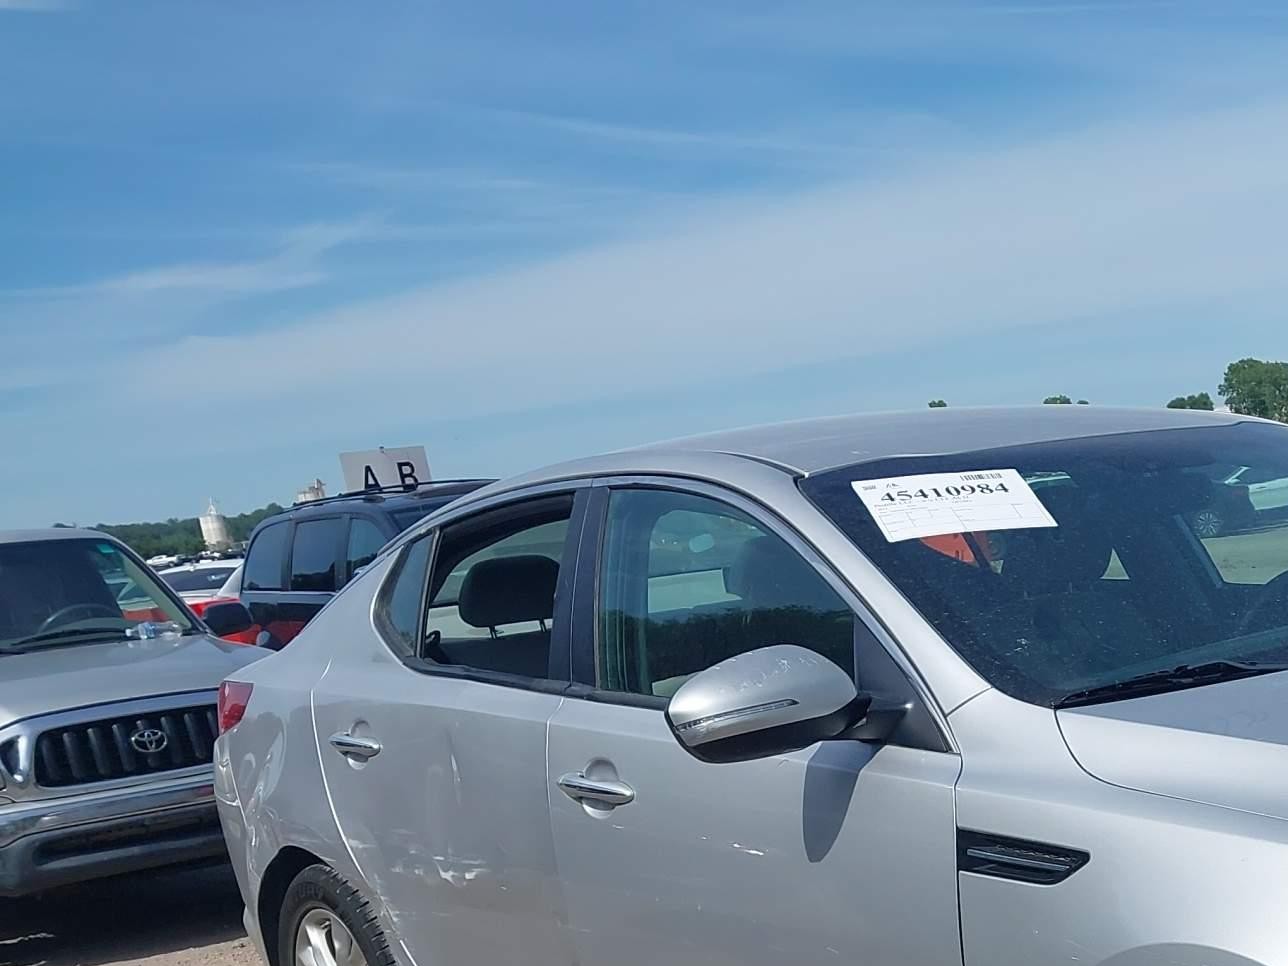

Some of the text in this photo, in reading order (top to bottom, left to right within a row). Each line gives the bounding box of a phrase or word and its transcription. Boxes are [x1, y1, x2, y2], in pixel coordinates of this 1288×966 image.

[364, 461, 419, 491] A B
[880, 482, 1010, 502] 45410984
